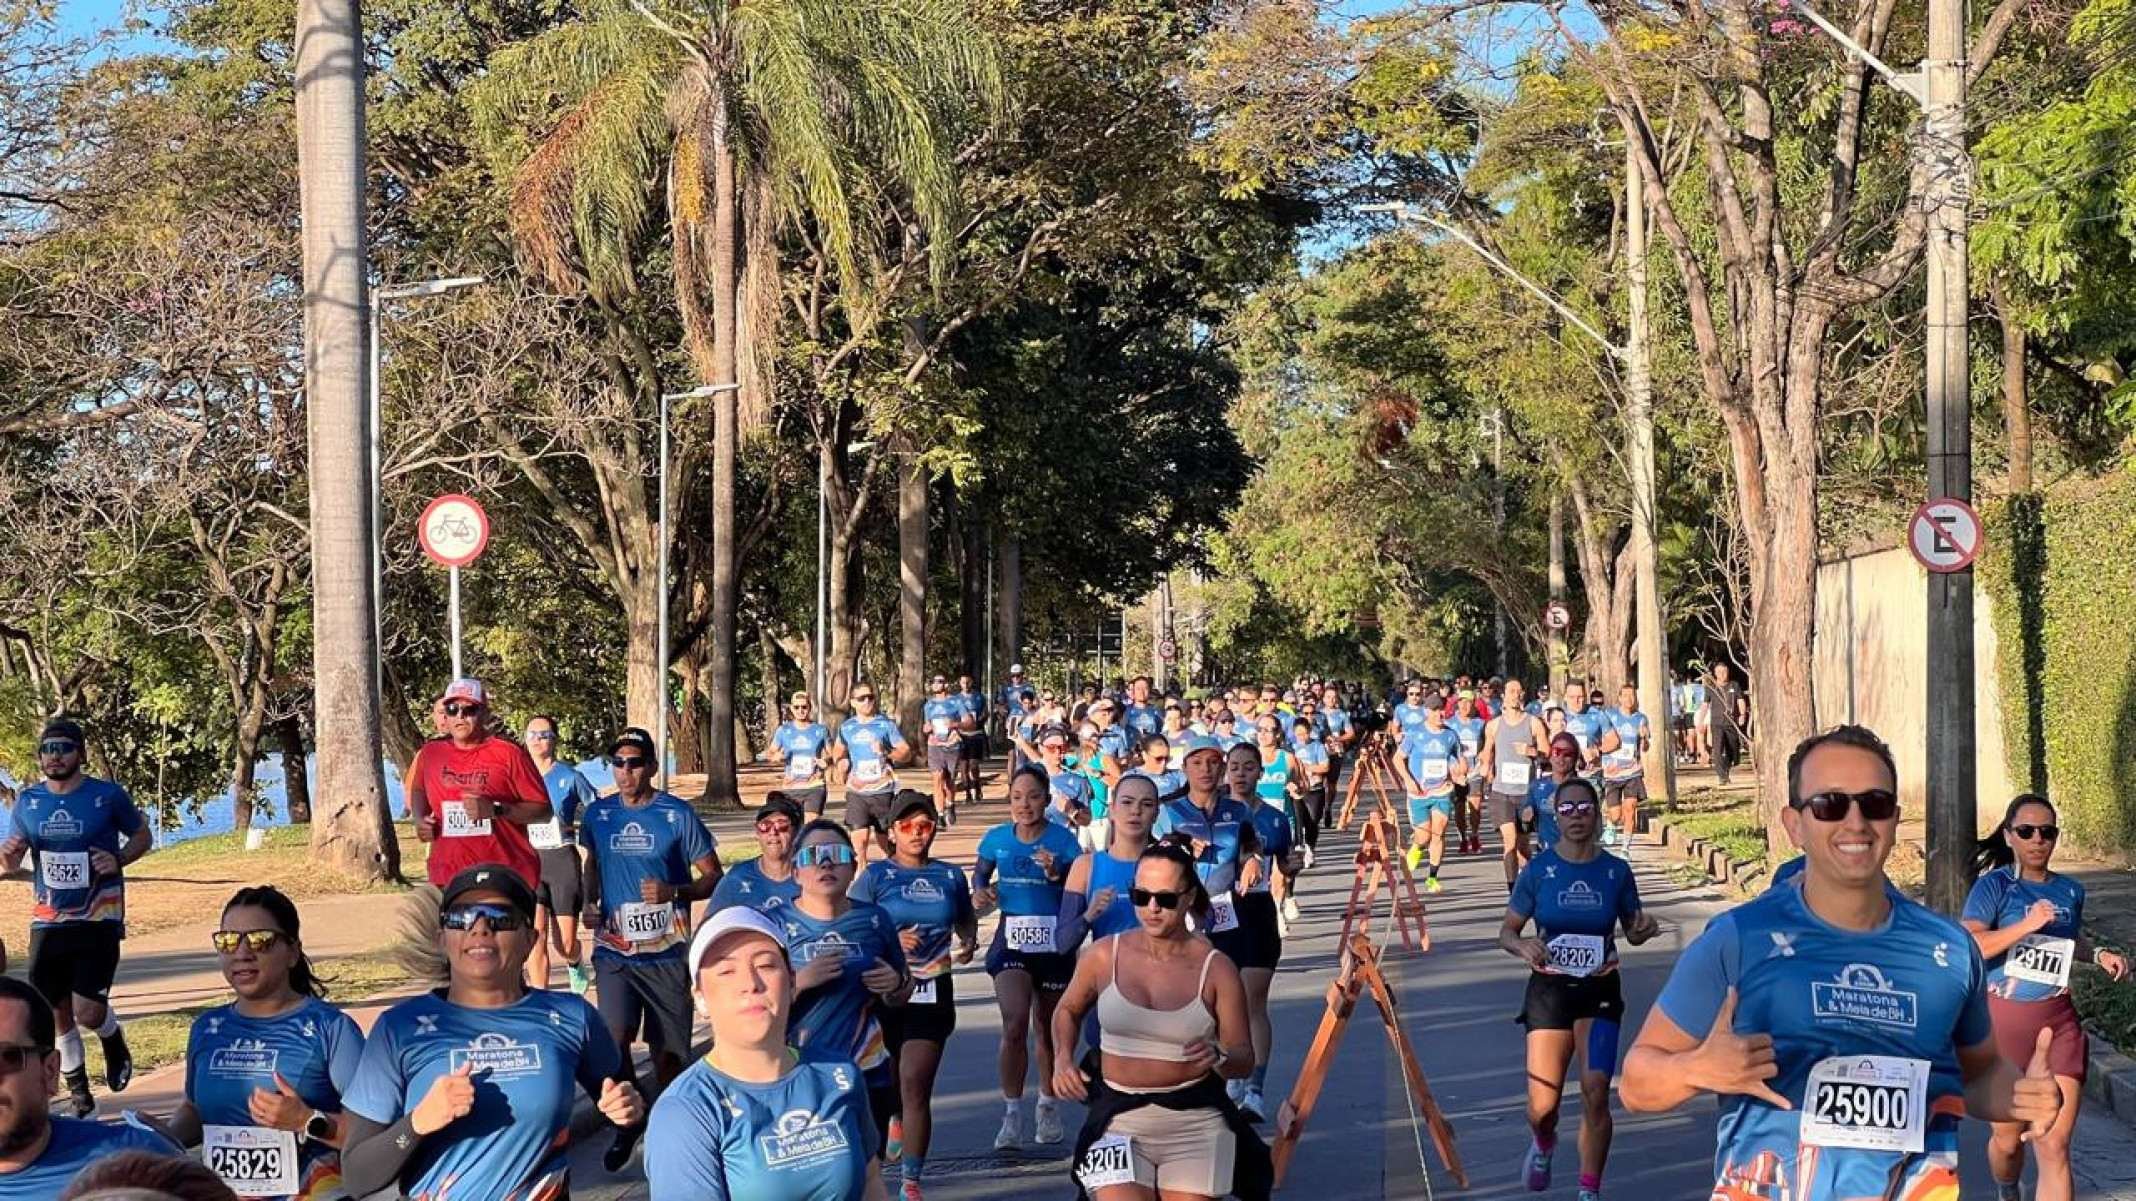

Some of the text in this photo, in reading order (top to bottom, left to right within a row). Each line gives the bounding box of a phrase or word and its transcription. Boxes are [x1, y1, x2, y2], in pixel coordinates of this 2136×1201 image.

[1011, 927, 1051, 944] 30586
[1551, 945, 1595, 967] 28202
[2016, 945, 2063, 974] 29177
[1832, 988, 1899, 1007] Maratona
[1871, 1005, 1888, 1018] de
[1815, 1083, 1909, 1129] 25900
[212, 1147, 281, 1179] 25829
